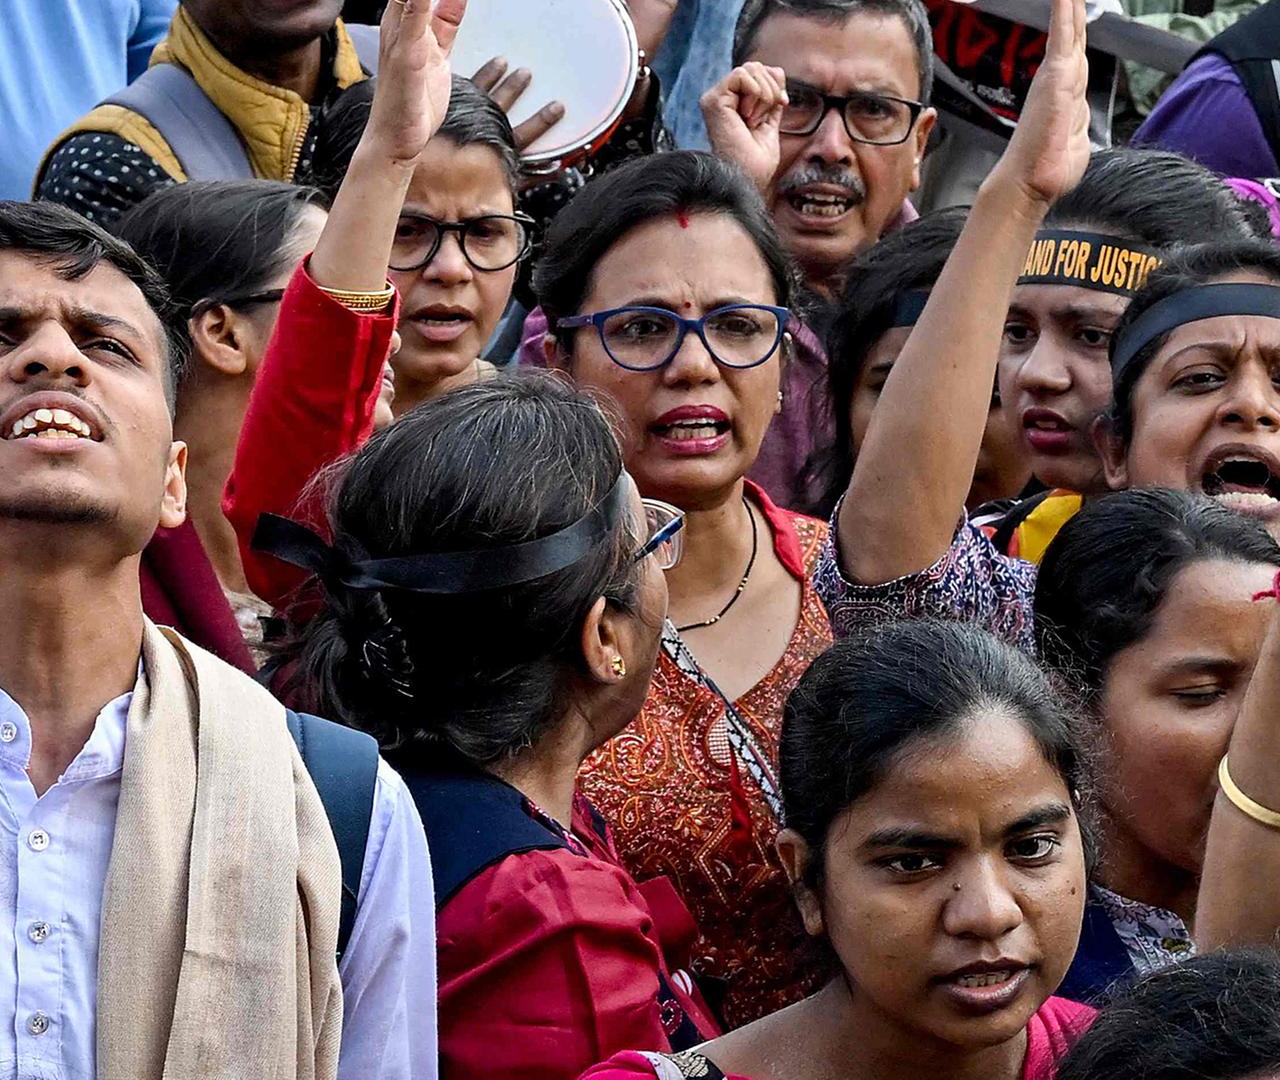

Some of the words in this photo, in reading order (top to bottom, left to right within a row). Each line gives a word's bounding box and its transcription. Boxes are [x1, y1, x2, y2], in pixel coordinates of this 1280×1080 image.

[1021, 240, 1055, 276] AND
[1054, 240, 1091, 279] FOR
[1091, 245, 1161, 291] JUSTIC
